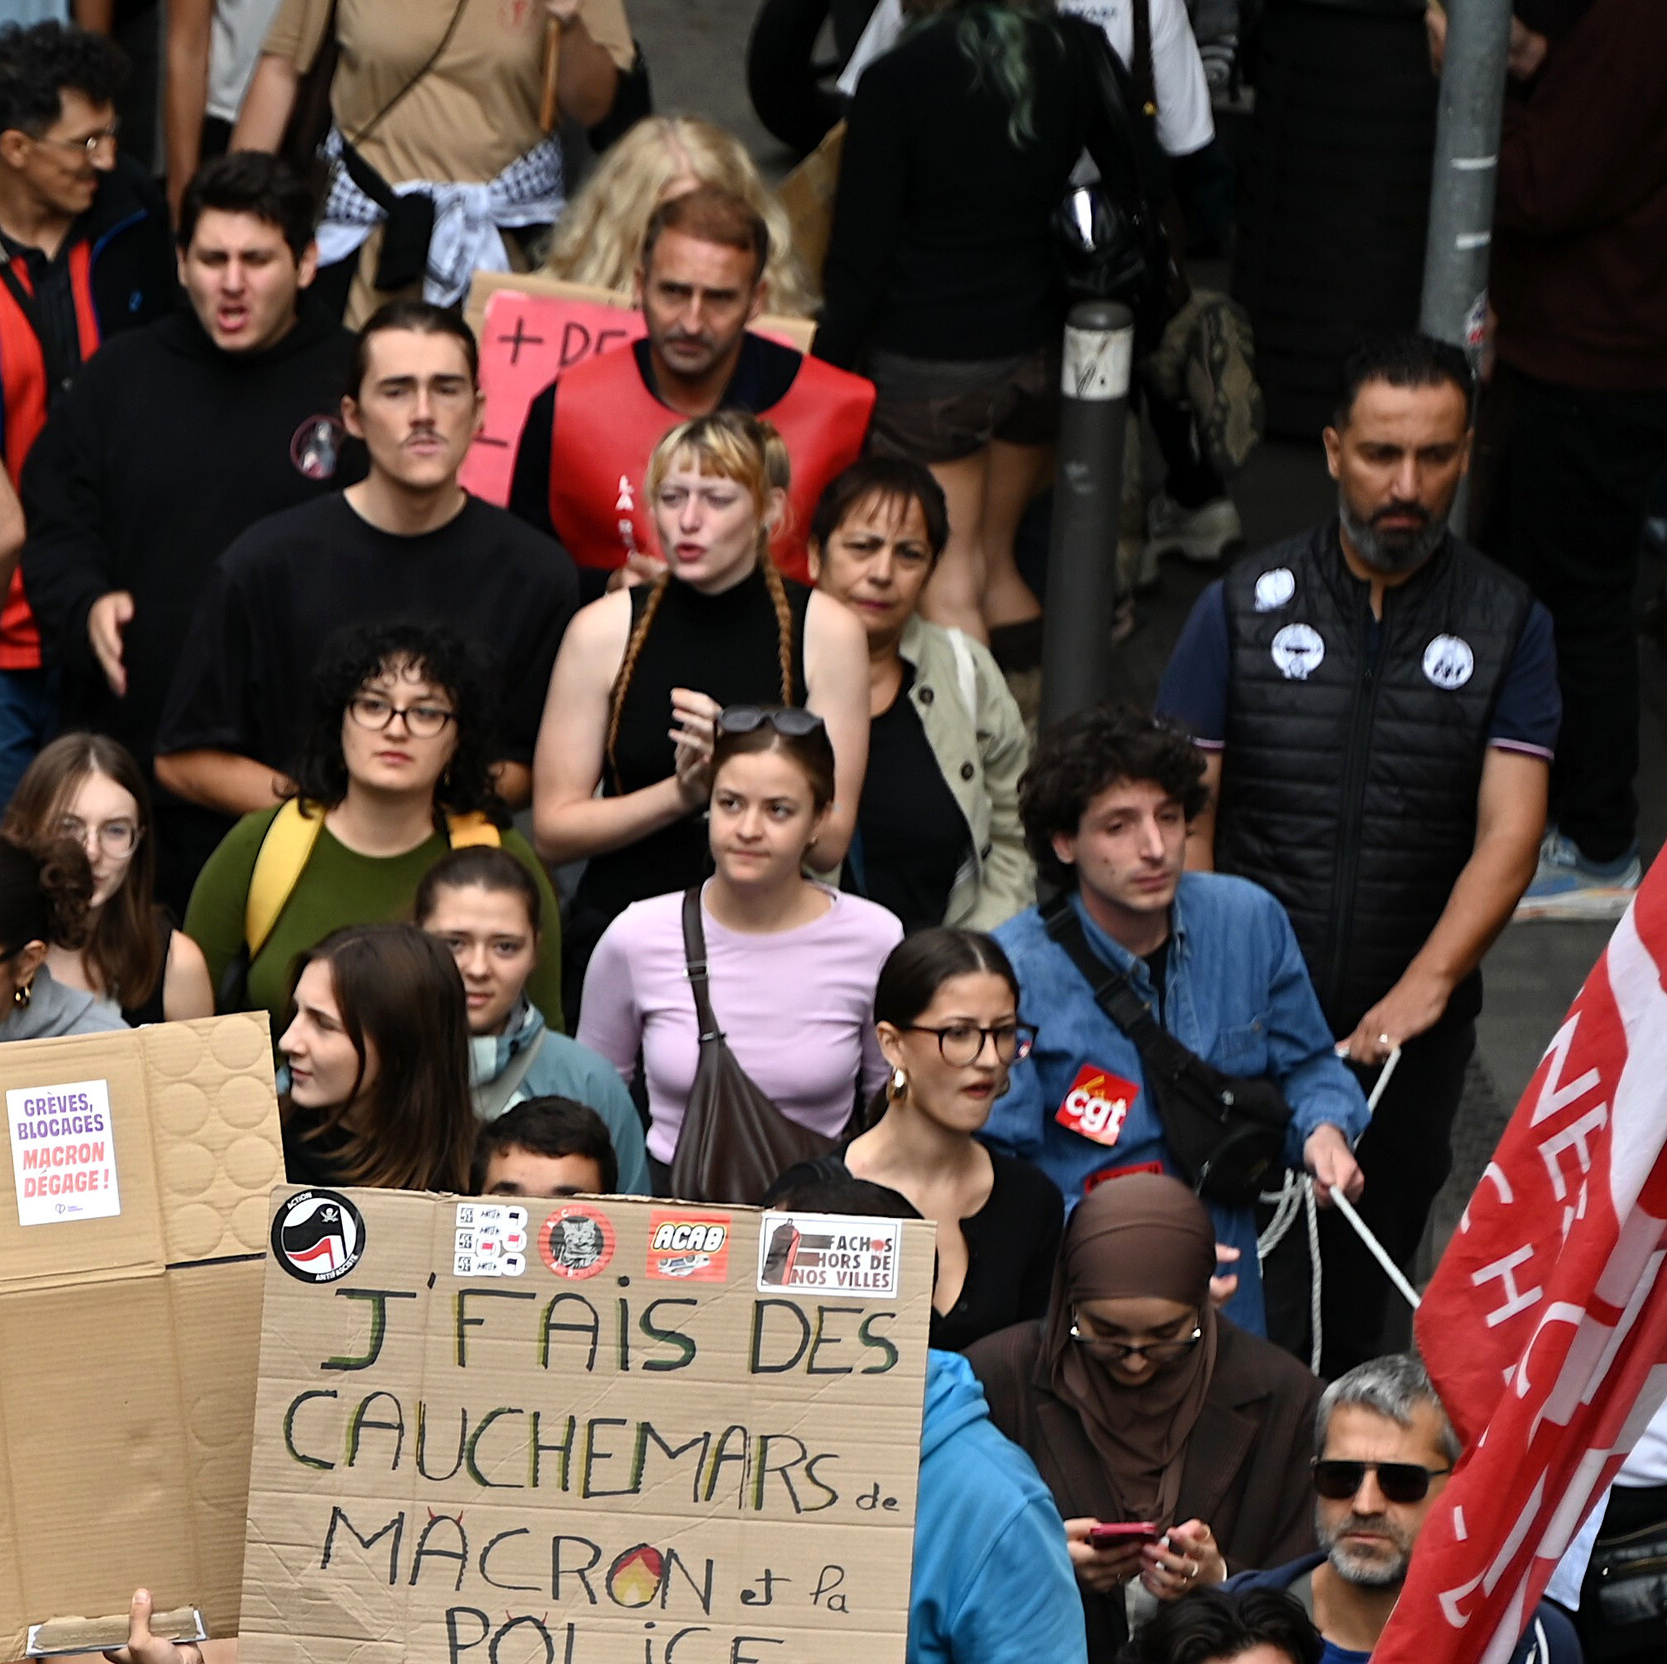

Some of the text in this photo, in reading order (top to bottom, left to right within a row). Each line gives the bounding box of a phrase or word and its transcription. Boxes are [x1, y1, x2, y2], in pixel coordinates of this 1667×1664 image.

[24, 1091, 93, 1117] GRÈVES,
[1065, 1088, 1126, 1132] cgt
[17, 1113, 105, 1141] BLOCAGES
[23, 1141, 105, 1170] MACRON
[24, 1168, 99, 1198] DÉGAGE
[653, 1224, 725, 1252] ACAB
[817, 1252, 891, 1271] HORS DE
[792, 1271, 890, 1289] NOS VILLES
[750, 1299, 899, 1375] DES
[284, 1390, 900, 1514] CAUCHEMARS de
[320, 1506, 715, 1616] MACRON
